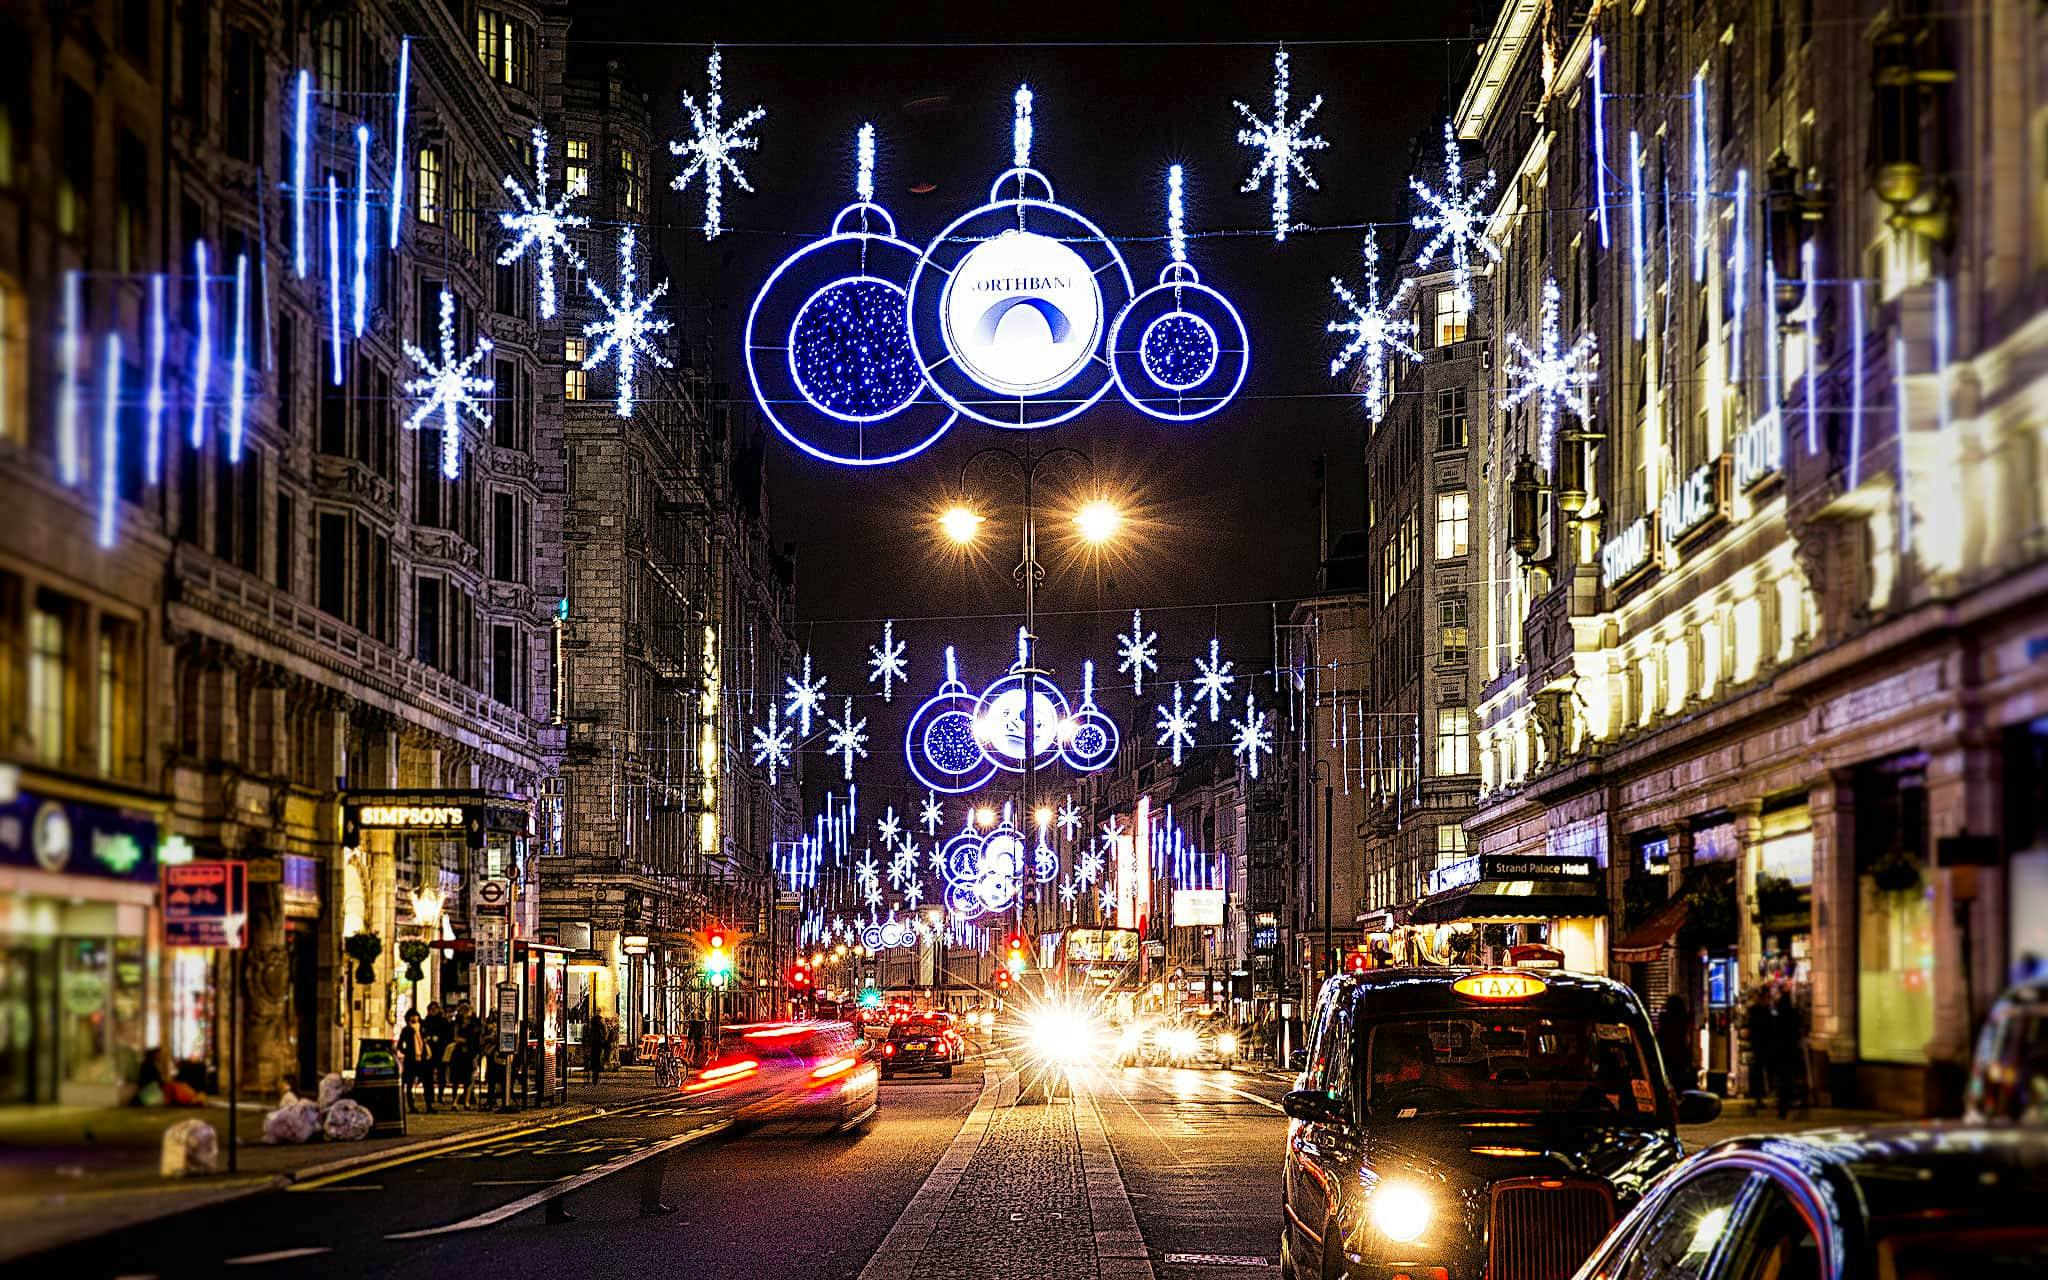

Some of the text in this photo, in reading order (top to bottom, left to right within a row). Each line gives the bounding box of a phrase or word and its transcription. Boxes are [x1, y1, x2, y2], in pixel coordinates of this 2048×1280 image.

[1603, 518, 1645, 588] STRAND
[1661, 465, 1710, 544] PALACE
[360, 807, 463, 825] SIMPSON'S
[1496, 863, 1589, 875] Strand Palace Hotel
[1474, 981, 1527, 995] TAXI
